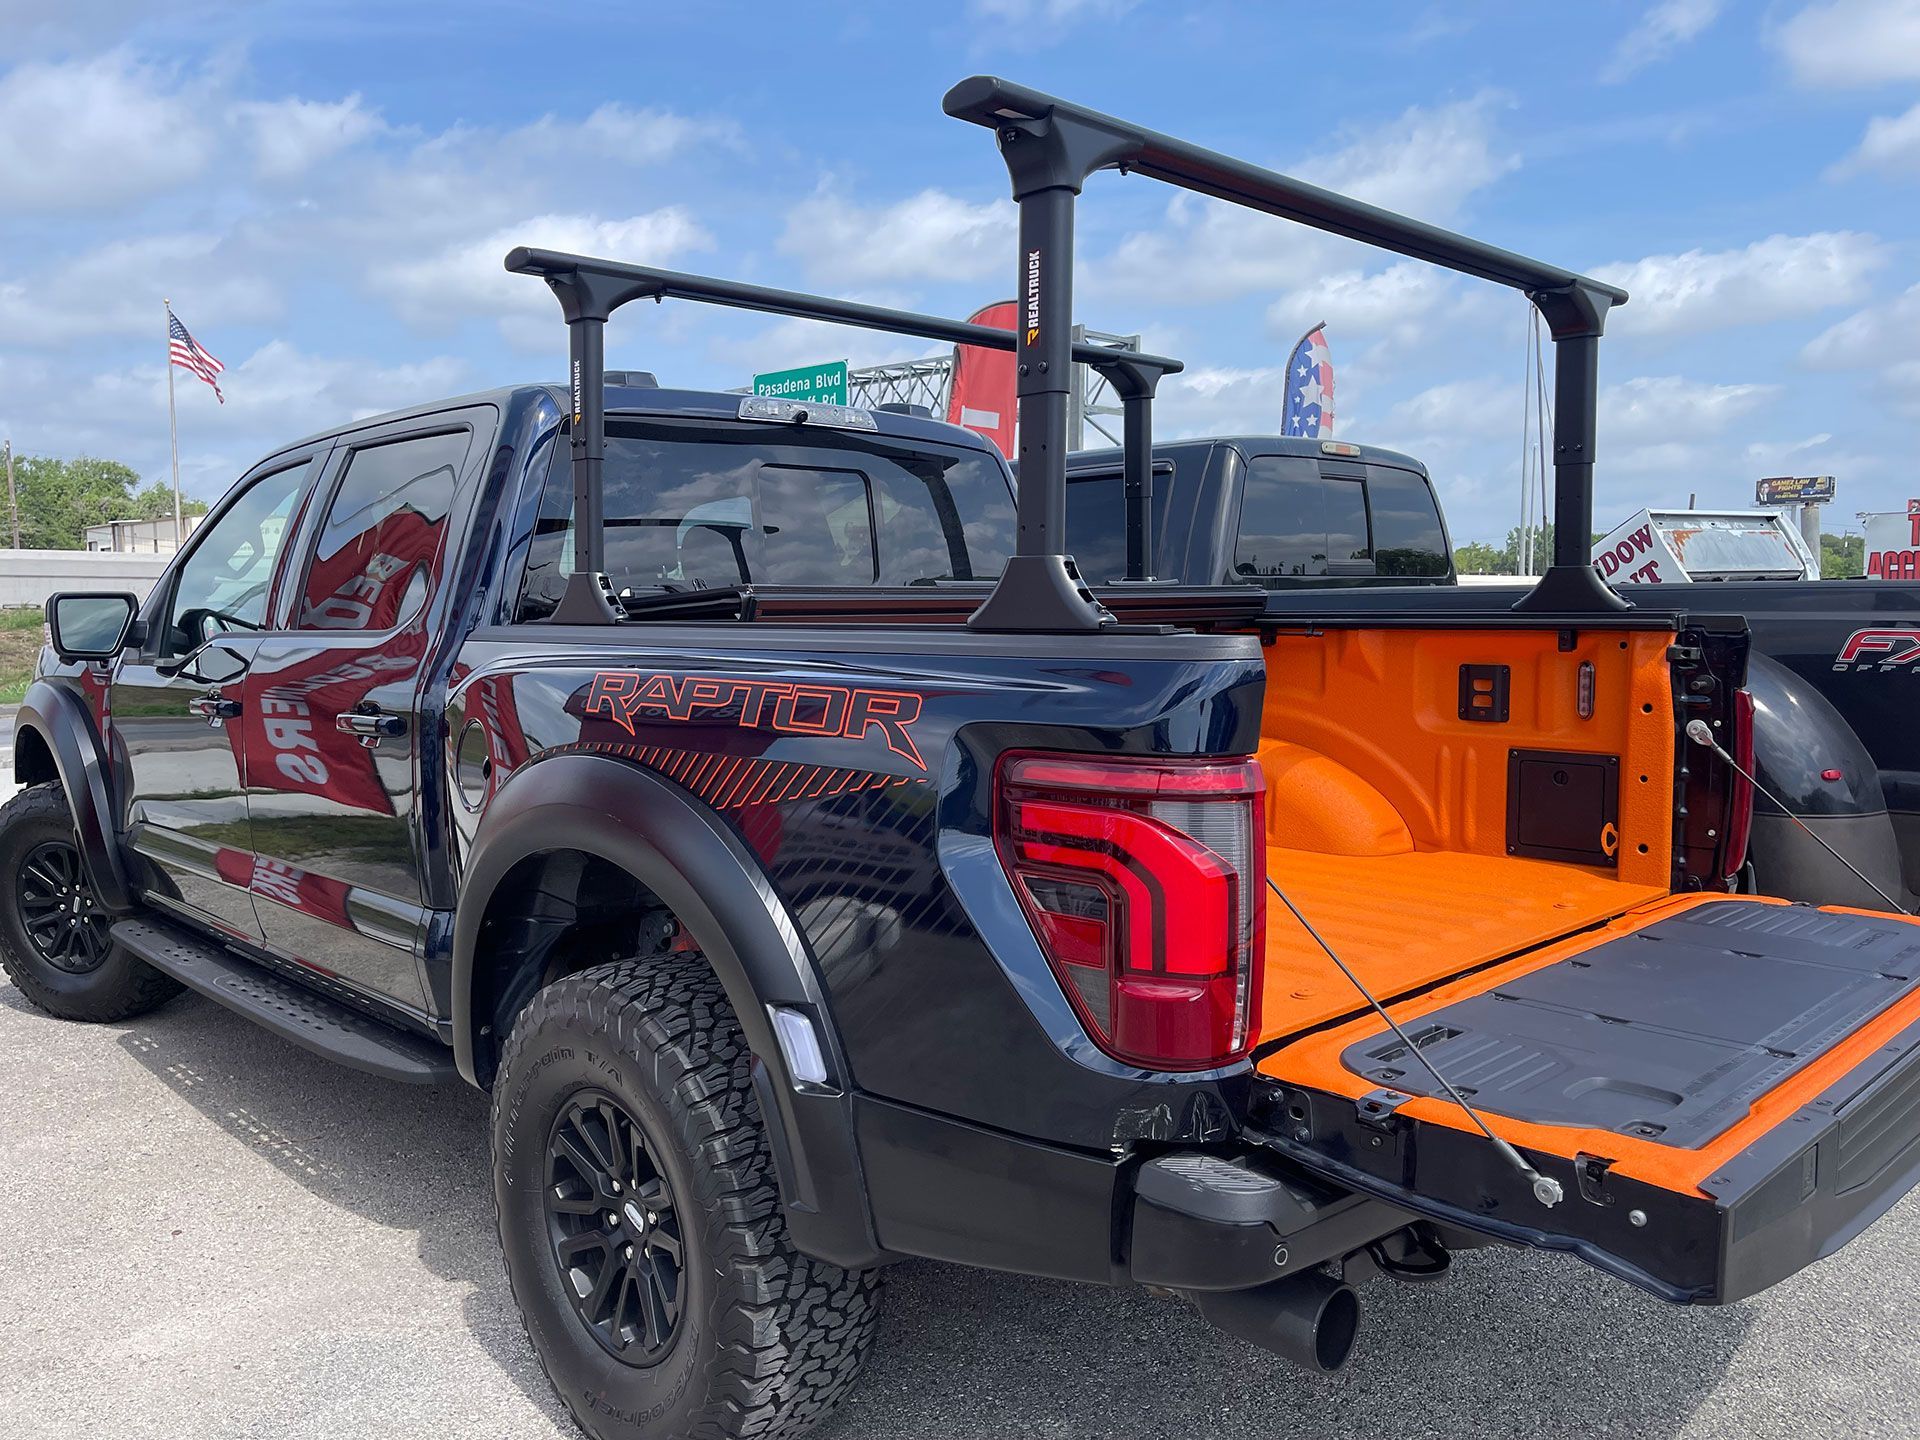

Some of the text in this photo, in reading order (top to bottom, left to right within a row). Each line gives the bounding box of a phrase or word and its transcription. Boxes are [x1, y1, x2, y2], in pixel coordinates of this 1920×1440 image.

[1028, 250, 1040, 328] REALTRUCK
[758, 371, 841, 397] Pasadena Blvd
[1592, 524, 1653, 577] DOW
[585, 672, 928, 771] RAPTOR
